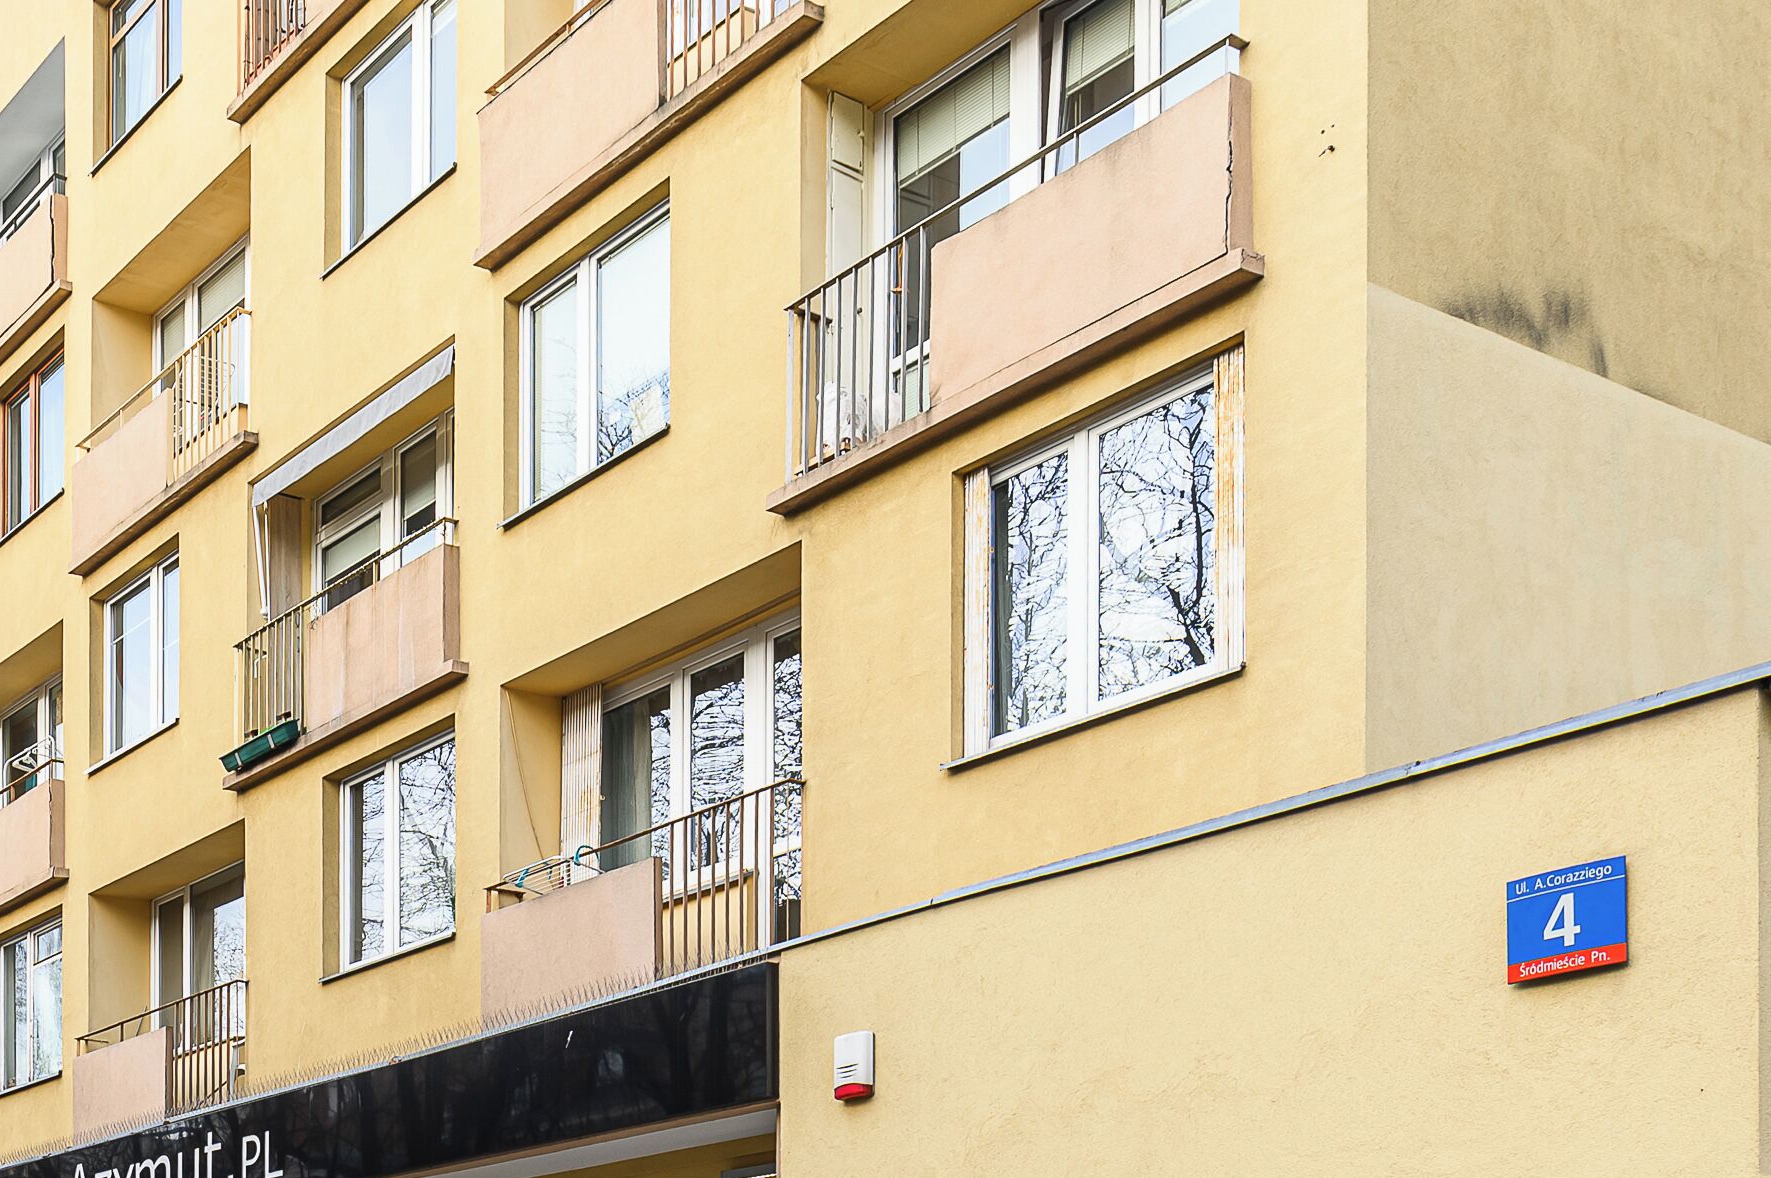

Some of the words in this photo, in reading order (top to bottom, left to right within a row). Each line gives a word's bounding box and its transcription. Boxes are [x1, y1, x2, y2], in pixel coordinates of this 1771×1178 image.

[1534, 865, 1612, 890] A.Corazziego
[1543, 892, 1581, 947] 4
[1519, 955, 1585, 977] Śródmieście
[1591, 950, 1611, 962] Pn.
